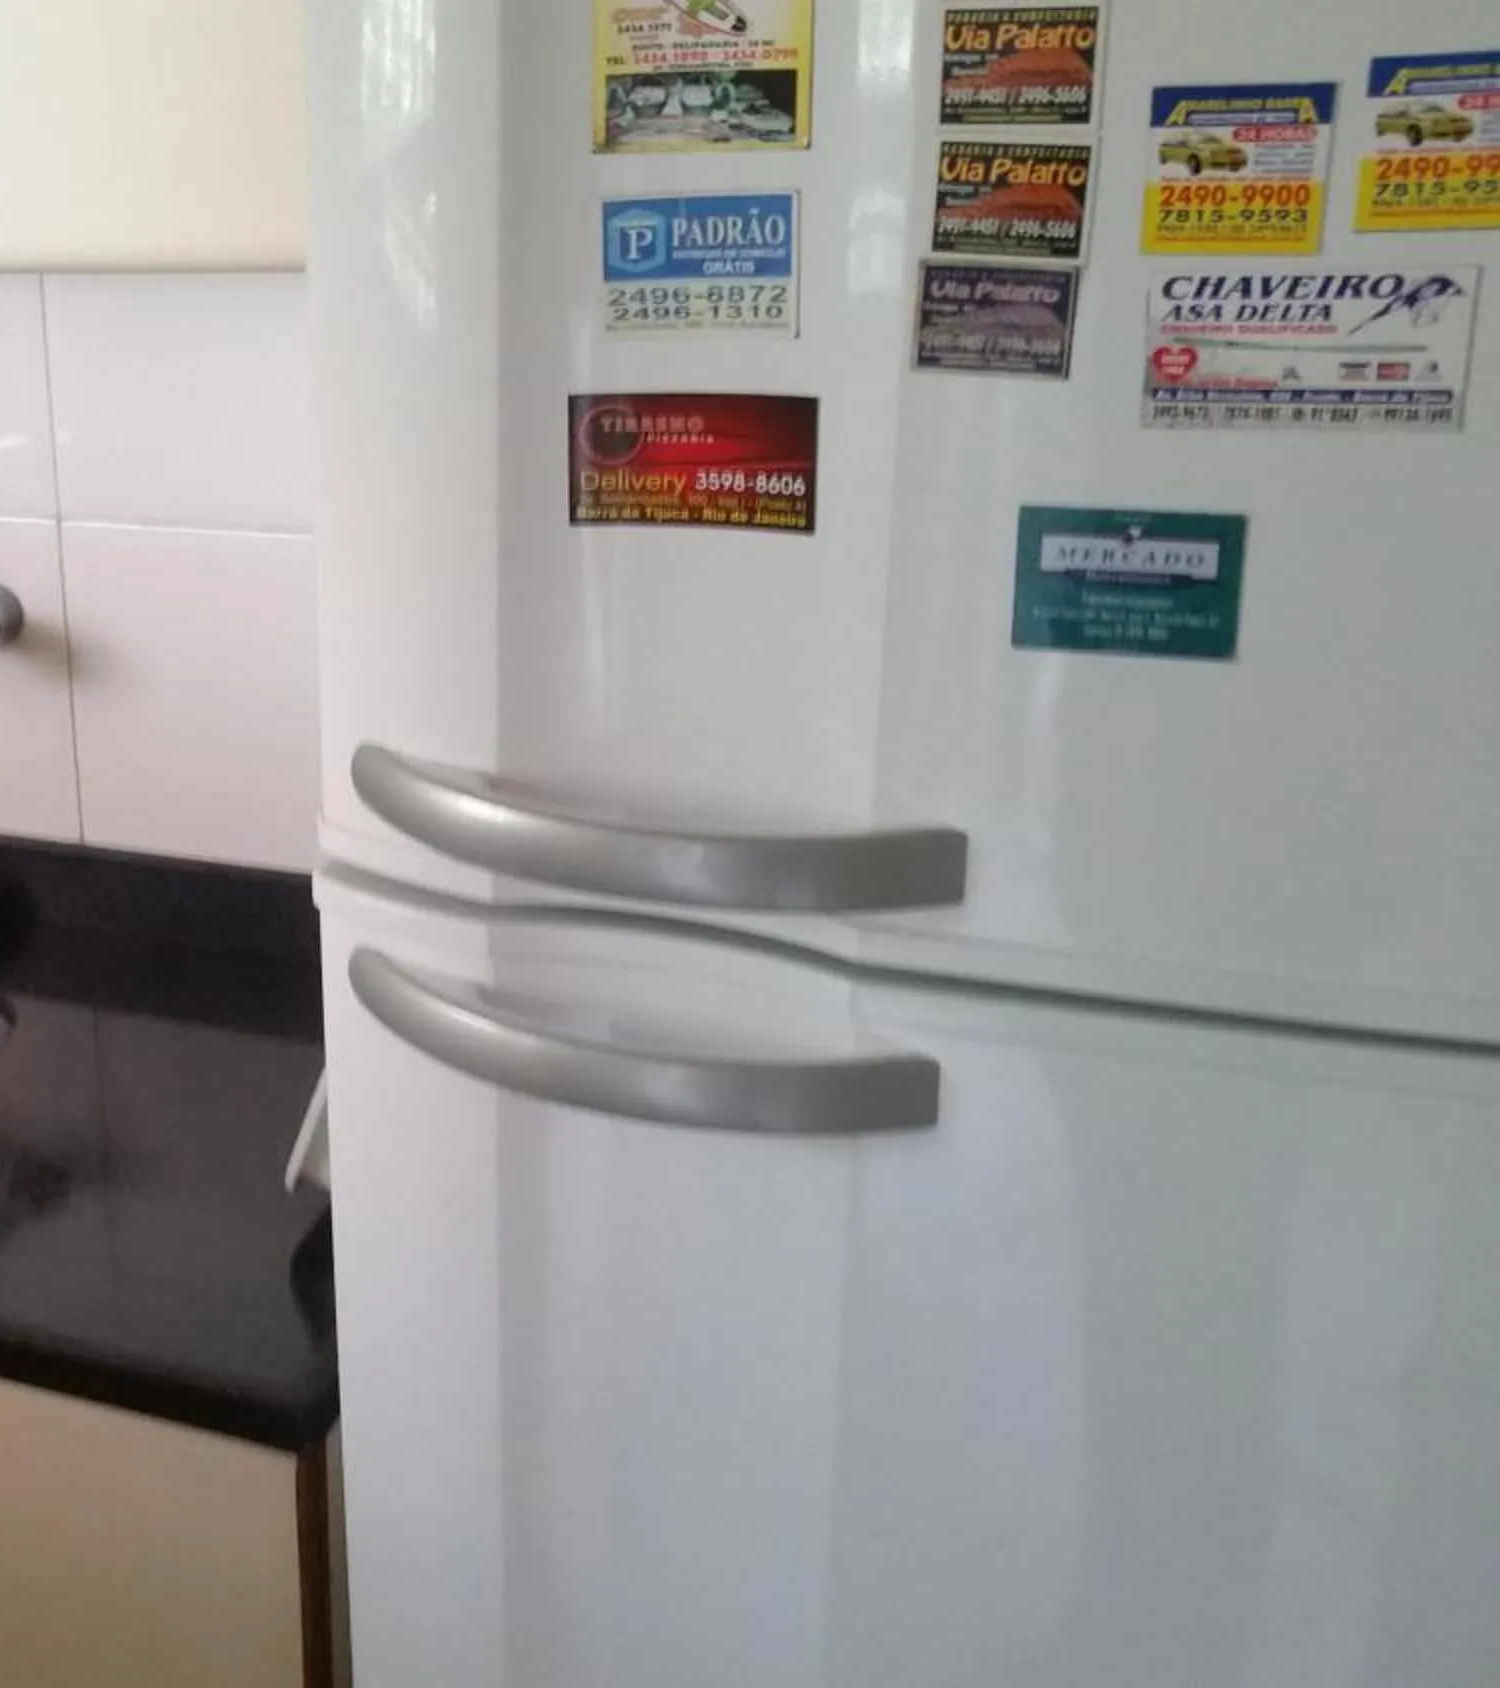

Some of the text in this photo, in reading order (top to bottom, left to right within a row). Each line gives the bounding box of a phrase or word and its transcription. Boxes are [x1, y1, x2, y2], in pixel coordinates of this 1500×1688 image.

[946, 23, 1095, 50] Via Palatto
[940, 156, 1088, 187] Via Palatto
[1160, 184, 1312, 208] 2490-9900
[671, 207, 787, 248] PADRÃO
[1159, 209, 1308, 223] 7815-9593
[626, 227, 653, 260] P
[1161, 274, 1405, 301] CHAVEIRO
[612, 304, 784, 322] 2496-1310
[1161, 303, 1333, 322] ASA DELTA
[579, 468, 807, 497] Delivery 3598-8606
[1056, 546, 1206, 570] MERCADO
